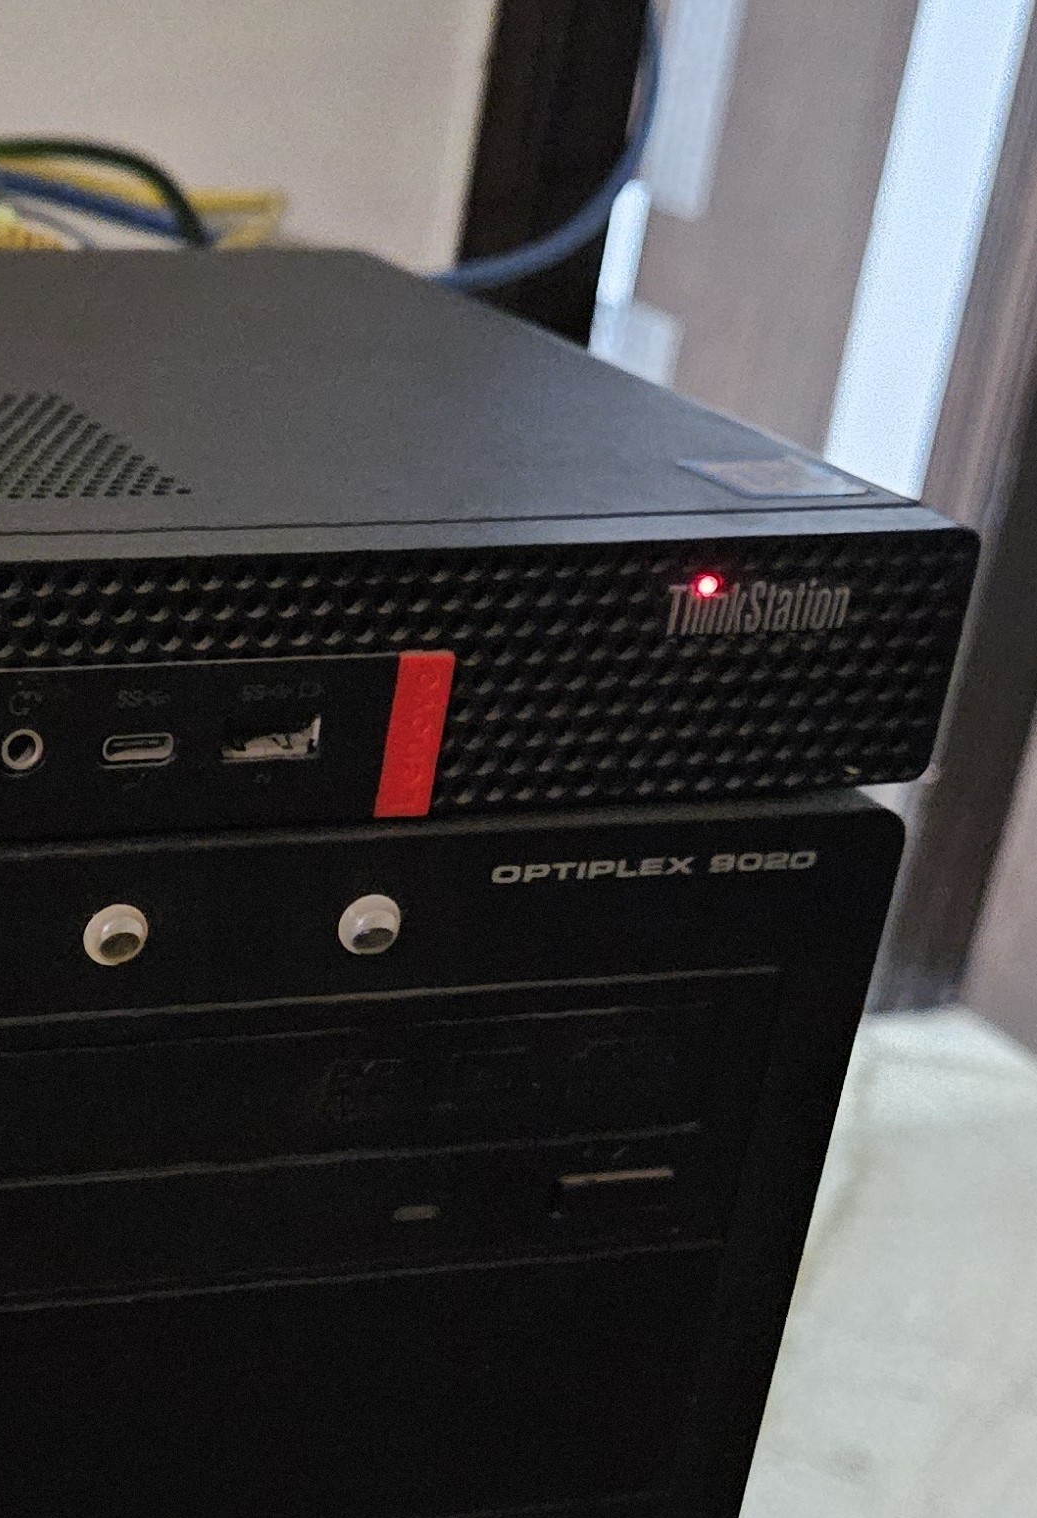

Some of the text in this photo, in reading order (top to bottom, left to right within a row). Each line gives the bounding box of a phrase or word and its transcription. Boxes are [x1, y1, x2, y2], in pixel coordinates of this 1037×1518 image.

[666, 577, 851, 635] ThinkStation
[491, 851, 818, 884] OPTIPLEX 9020
